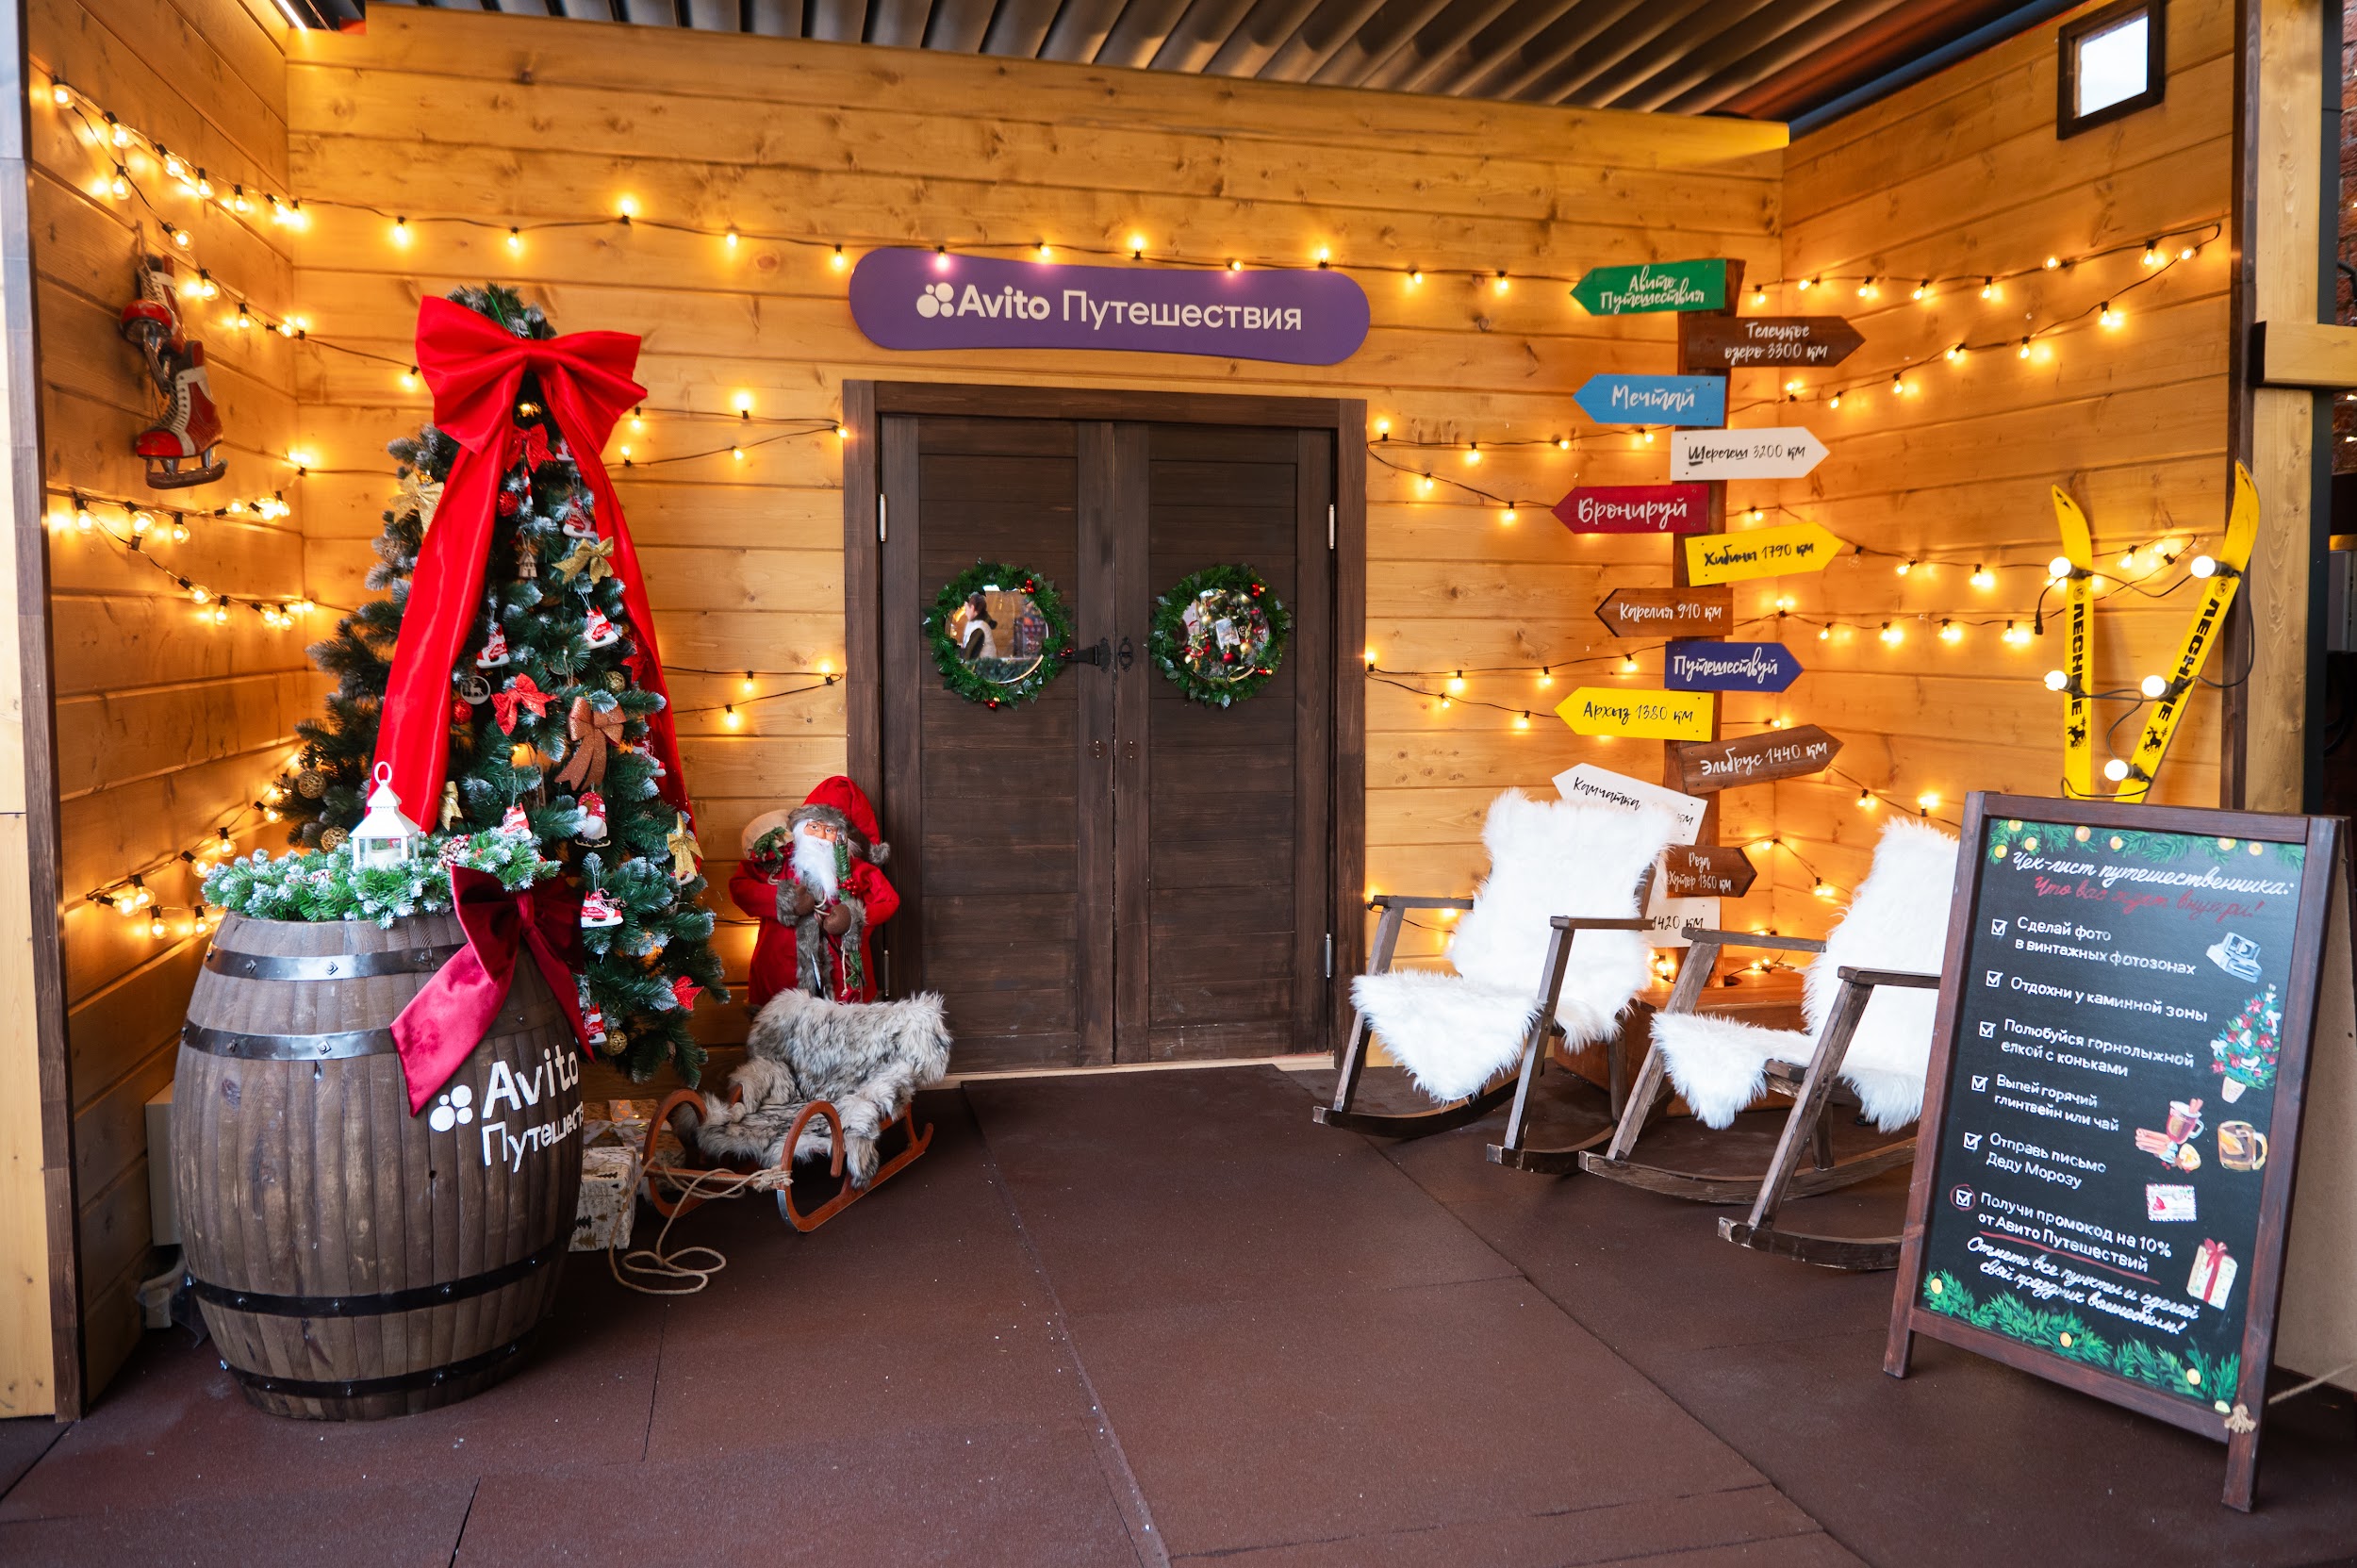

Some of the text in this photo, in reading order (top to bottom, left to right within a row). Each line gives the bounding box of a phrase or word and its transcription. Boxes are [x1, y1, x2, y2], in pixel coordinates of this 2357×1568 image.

[1600, 277, 1705, 314] Путешествия
[1628, 265, 1678, 292] Авито
[956, 284, 1304, 331] Avito Путешествия
[1745, 322, 1810, 341] Телецкое
[1724, 342, 1829, 366] озеро 3300 км
[1611, 384, 1696, 412] Мечтай
[1688, 444, 1806, 462] Шерегеш 3200 км
[1577, 497, 1689, 529] Бронируй
[1704, 542, 1815, 567] Хибины 1790 км
[1619, 602, 1722, 623] Карелия 910 км
[1673, 647, 1779, 684] Путешествуй
[2071, 603, 2085, 716] ЛЕСНЕ
[2157, 597, 2221, 722] ЛЕСНЕ
[1582, 701, 1694, 726] Архыз 1380 км
[1700, 742, 1828, 777] Эльбрус 1440 км
[1573, 777, 1641, 811] Камчатка
[1689, 851, 1711, 874] Роза
[2013, 850, 2295, 895] Чек-лист путешественника:
[1668, 870, 1732, 893] Хутор 1360 км
[2035, 875, 2072, 897] Что
[2017, 916, 2112, 942] Сделай фото
[2015, 938, 2197, 975] в винтажных фотозонах
[2010, 977, 2208, 1023] Отдохни у каминной зоны
[2004, 1018, 2195, 1067] Полюбуйся горнолыжной
[482, 1044, 579, 1119] Avito
[2045, 1050, 2054, 1062] с
[2056, 1052, 2129, 1077] коньками
[1996, 1073, 2098, 1109] Выпей горячий
[1994, 1095, 2119, 1131] глинтвейн или чай
[1986, 1151, 2083, 1190] Деду Морозу
[1989, 1132, 2107, 1174] Отправь письмо
[1978, 1213, 2149, 1273] от Авито Путешествий
[1980, 1192, 2172, 1259] Получи промокод на 10%
[1967, 1236, 2030, 1267] Отметь
[2032, 1254, 2059, 1278] все
[2060, 1267, 2123, 1296] пункты
[2139, 1292, 2200, 1320] сделай
